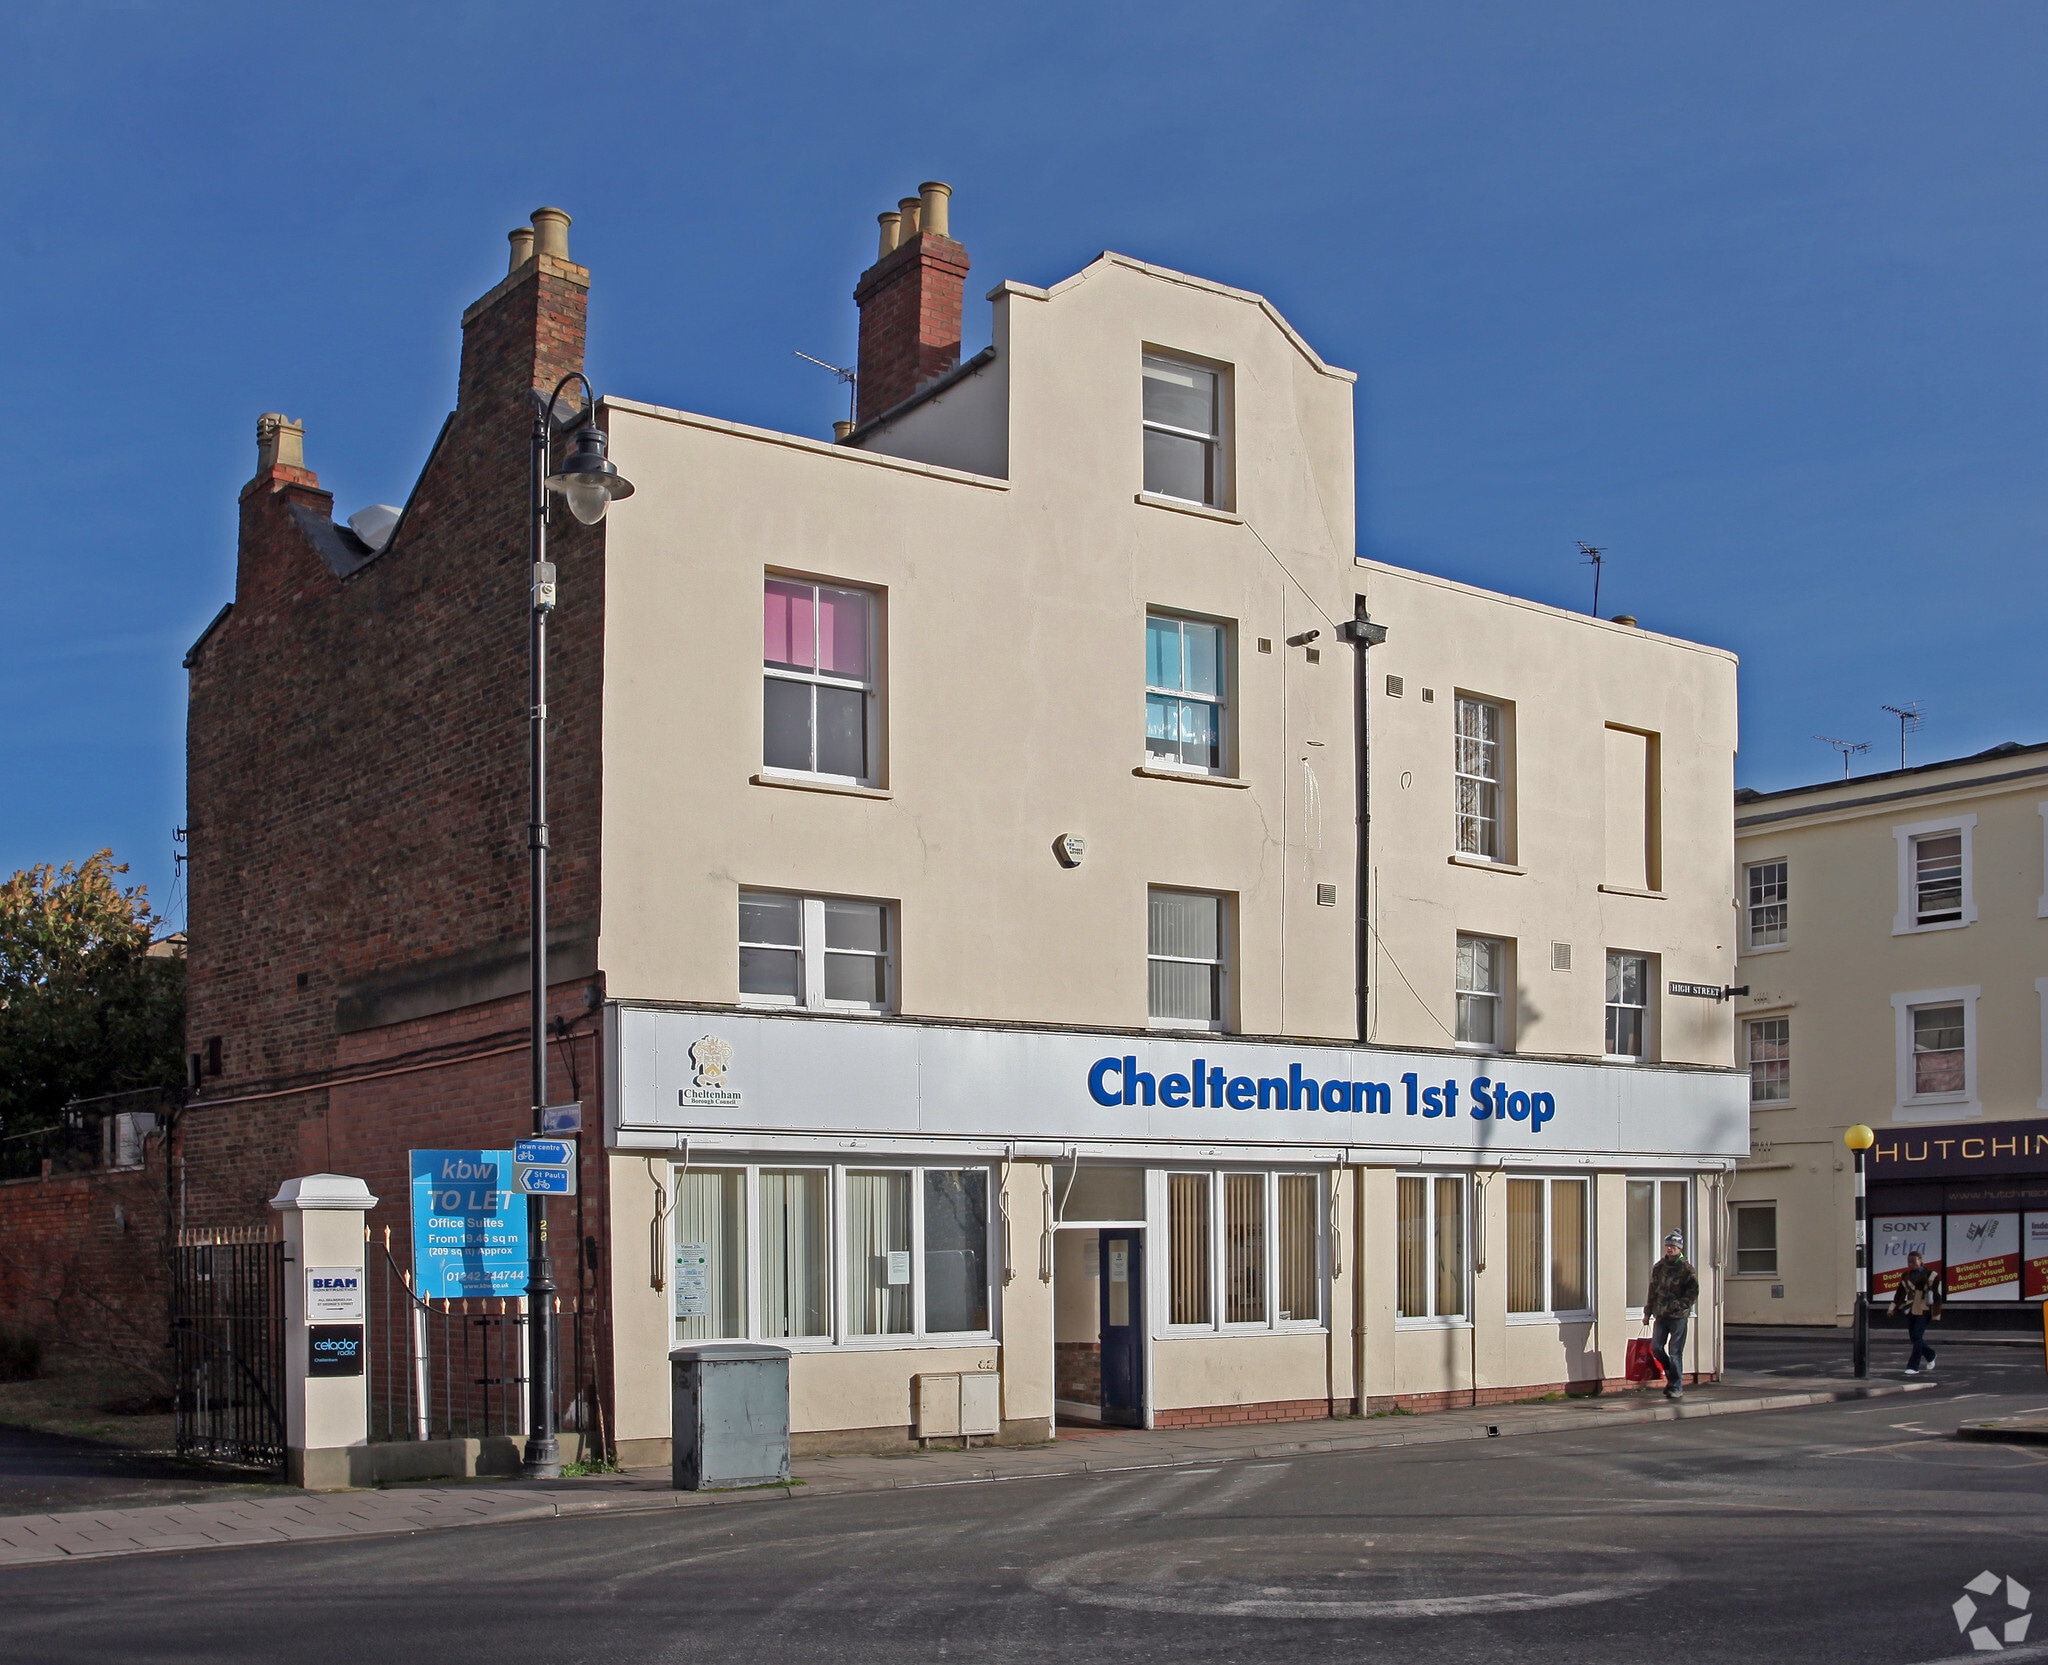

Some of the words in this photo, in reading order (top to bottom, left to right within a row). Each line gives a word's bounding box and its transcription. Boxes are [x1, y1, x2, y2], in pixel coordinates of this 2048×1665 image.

[1672, 984, 1690, 993] HIGH
[1693, 987, 1719, 996] STREET
[684, 1089, 741, 1099] Cheltenham
[1087, 1056, 1392, 1115] Cheltenham
[1400, 1072, 1460, 1118] 1st
[1470, 1076, 1556, 1133] Stop
[442, 1158, 494, 1179] kbw
[427, 1190, 461, 1210] TO
[468, 1190, 514, 1210] LET
[428, 1218, 464, 1228] Office
[467, 1218, 504, 1228] Suites
[1882, 1222, 1930, 1232] SONY
[1966, 1222, 1978, 1241] ERT
[428, 1234, 458, 1243] From
[461, 1234, 489, 1243] 19.46
[492, 1235, 506, 1244] sq
[429, 1248, 448, 1257] (209
[451, 1248, 462, 1257] sq
[465, 1247, 475, 1256] ft)
[477, 1247, 512, 1256] Approx
[1956, 1263, 1986, 1273] Britain's
[446, 1272, 480, 1281] 01242
[484, 1270, 524, 1281] 244744
[1958, 1267, 2005, 1281] Audio/Visual
[313, 1279, 357, 1288] BEAM
[1948, 1282, 1976, 1292] Retailer
[1978, 1273, 2018, 1286] 2008/2009
[314, 1338, 359, 1350] celador
